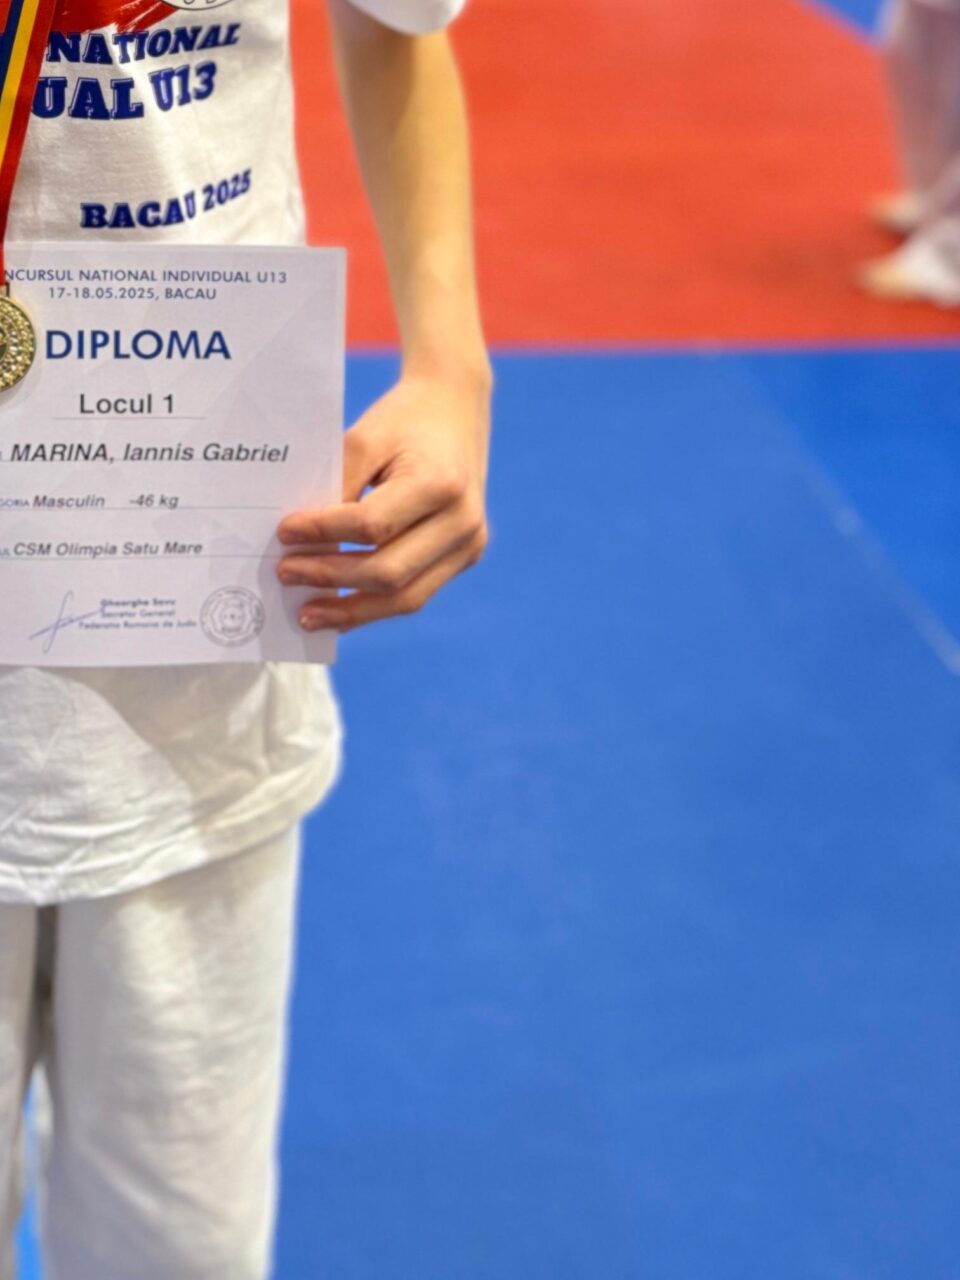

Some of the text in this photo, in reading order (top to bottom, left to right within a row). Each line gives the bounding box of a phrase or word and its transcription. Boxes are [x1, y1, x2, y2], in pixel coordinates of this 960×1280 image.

[46, 23, 241, 65] NATIONAL
[148, 60, 217, 112] U13
[80, 168, 252, 229] BACAU 2025
[4, 269, 288, 284] NCURSUL NATIONAL INDIVIDUAL U13
[48, 287, 218, 301] 17-18.05.2025, BACAU
[45, 329, 232, 360] DIPLOMA
[79, 393, 174, 415] Locul 1
[10, 443, 115, 464] MARINA,
[123, 443, 194, 462] Iannis
[202, 443, 290, 463] Gabriel
[32, 495, 106, 509] Masculin
[129, 494, 155, 508] -46
[159, 494, 180, 510] kg
[13, 542, 52, 556] CSM
[55, 542, 118, 559] Olimpia
[122, 541, 159, 556] Satu
[163, 541, 203, 555] Mare
